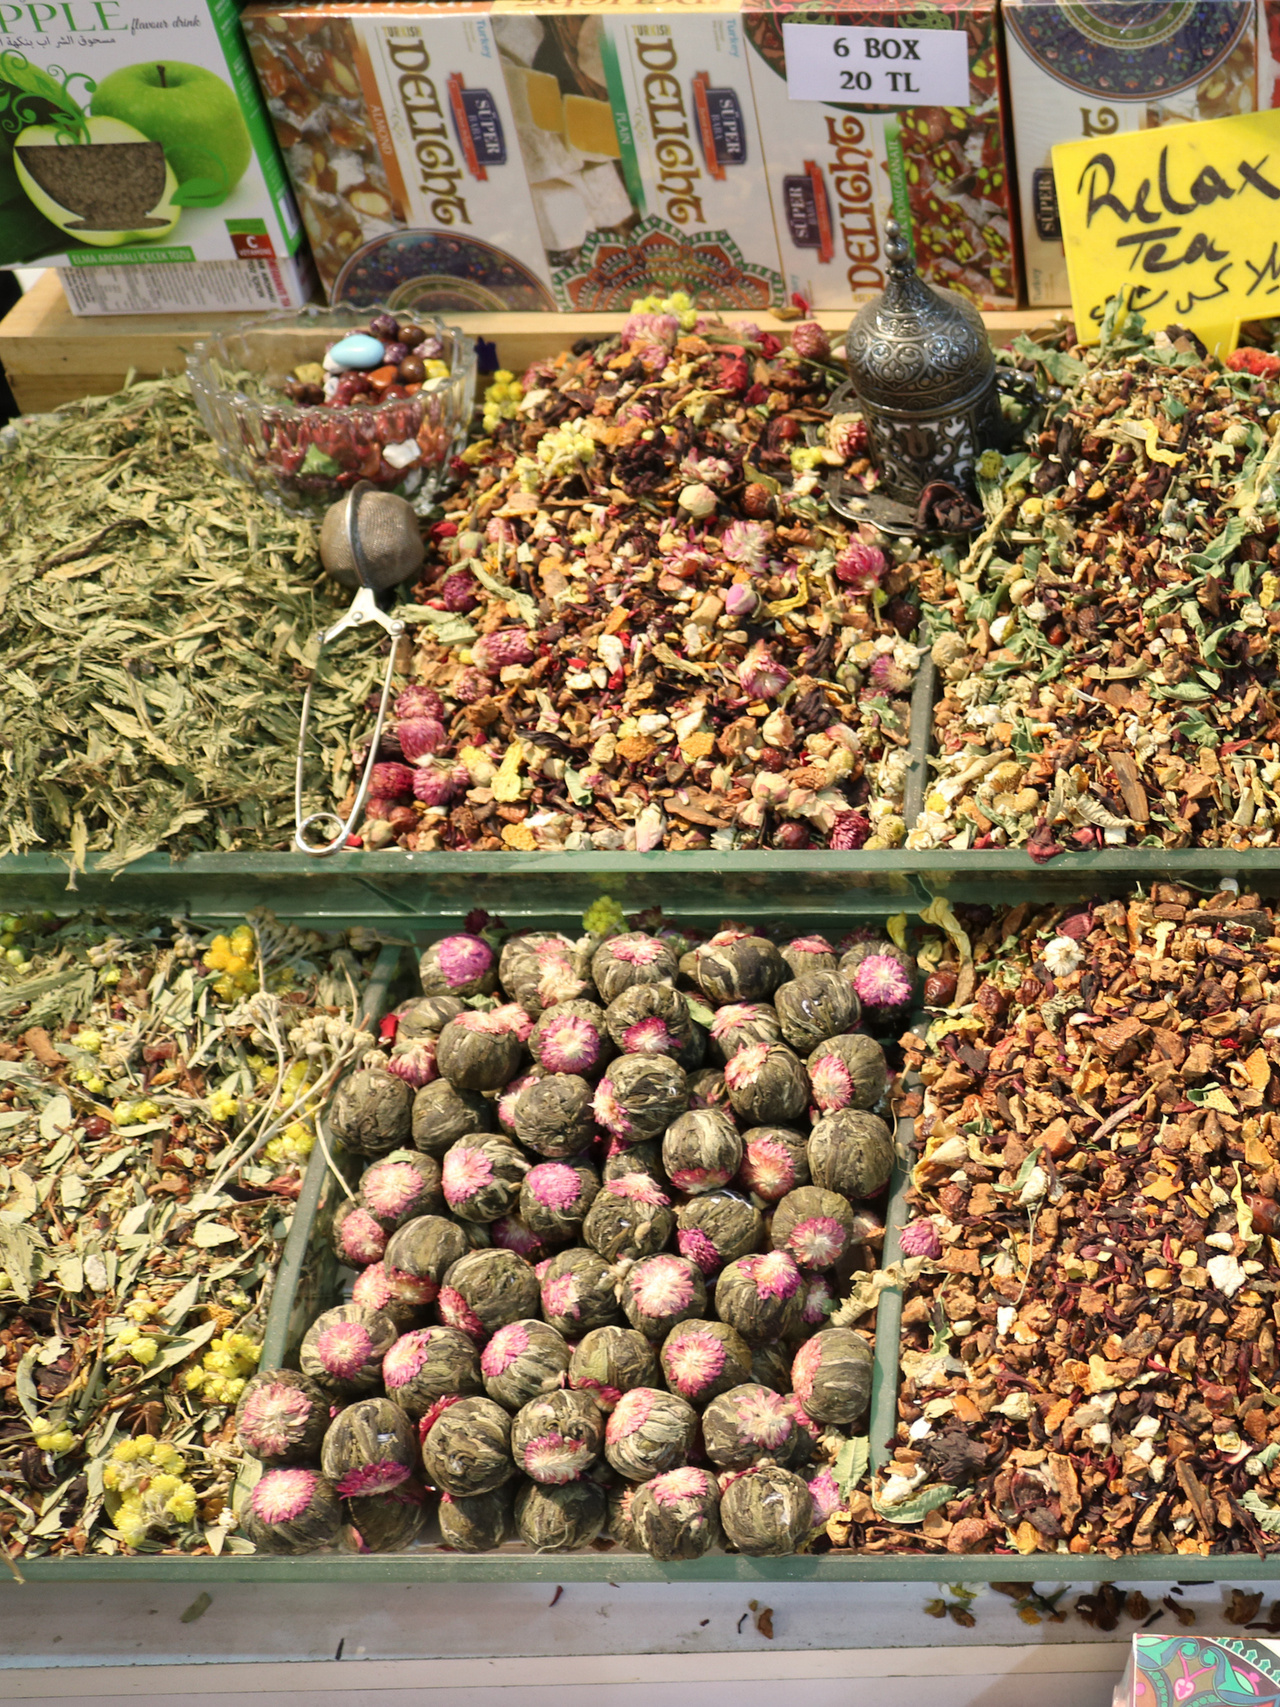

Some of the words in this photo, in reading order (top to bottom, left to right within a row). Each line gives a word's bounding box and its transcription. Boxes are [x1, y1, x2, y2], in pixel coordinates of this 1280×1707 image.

[131, 18, 169, 35] flavour
[172, 15, 201, 28] drink
[476, 20, 491, 58] Turkey
[833, 37, 850, 57] 6
[864, 37, 921, 60] BOX
[840, 70, 872, 91] 20
[885, 71, 920, 93] TL
[371, 104, 393, 155] ALMOND
[475, 100, 500, 154] SÜPER
[615, 112, 632, 145] PLAIN
[719, 99, 740, 153] SÜPER
[789, 187, 809, 238] SÜPER
[1038, 178, 1055, 232] SÜPER
[246, 235, 258, 249] C
[1116, 226, 1230, 273] Tea
